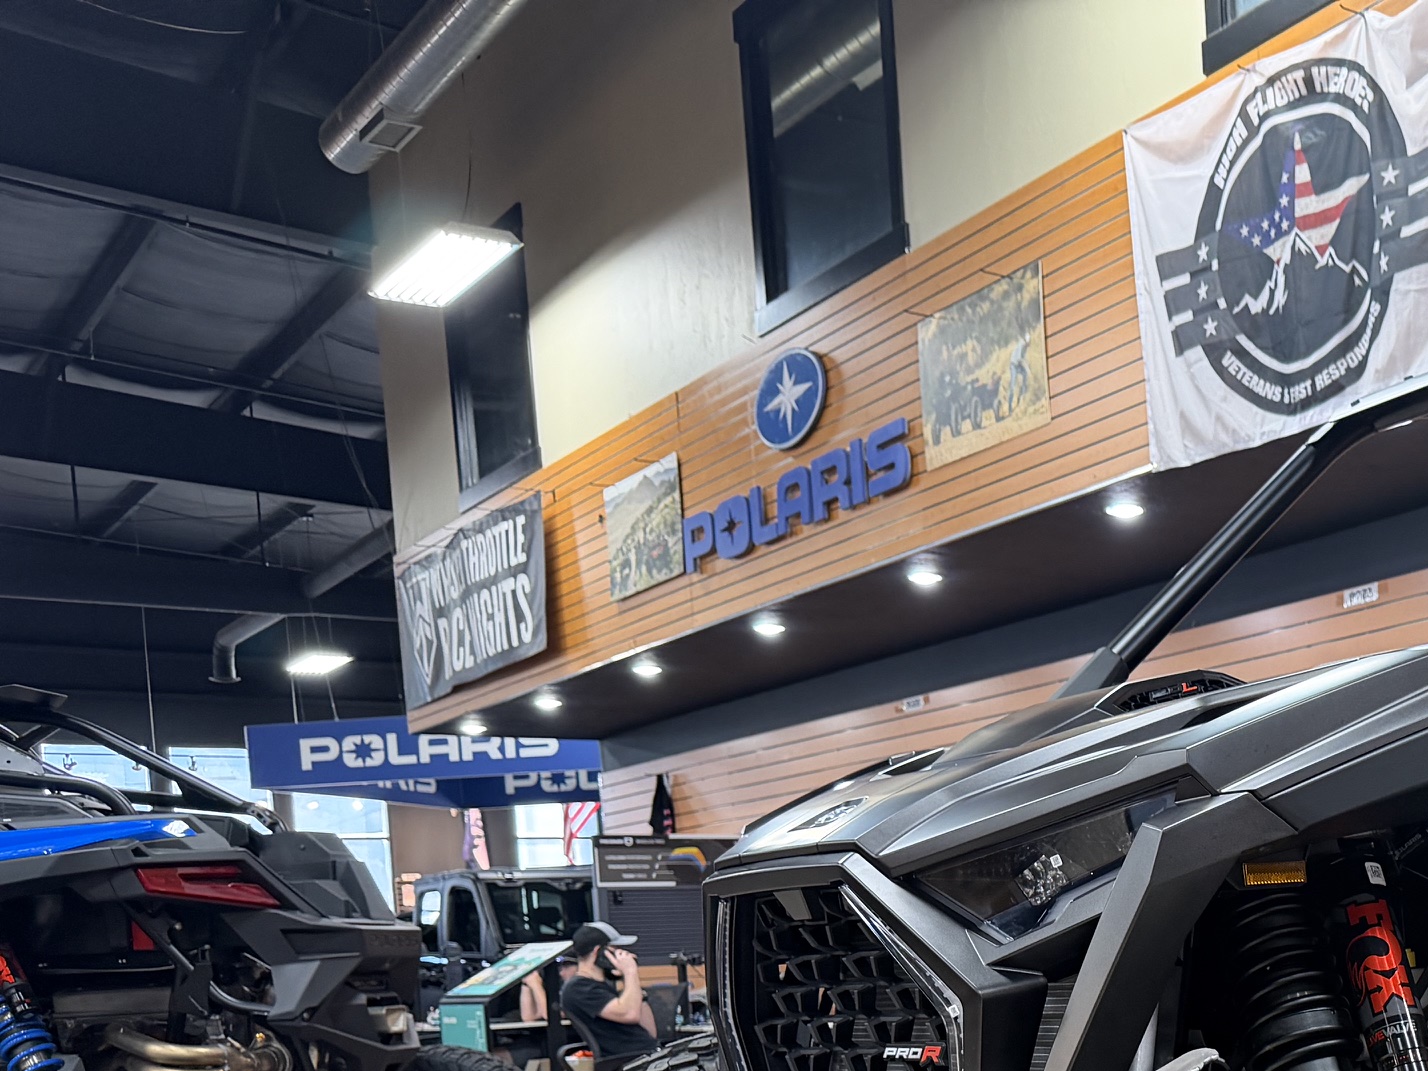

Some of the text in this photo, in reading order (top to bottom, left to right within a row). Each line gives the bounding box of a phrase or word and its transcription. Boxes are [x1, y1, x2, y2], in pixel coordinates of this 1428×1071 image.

[1246, 68, 1309, 127] FLIGHT
[1220, 349, 1283, 403] VETERANS
[683, 416, 912, 576] POLARIS
[460, 514, 528, 587] THROTTLE
[298, 731, 560, 771] POLARIS
